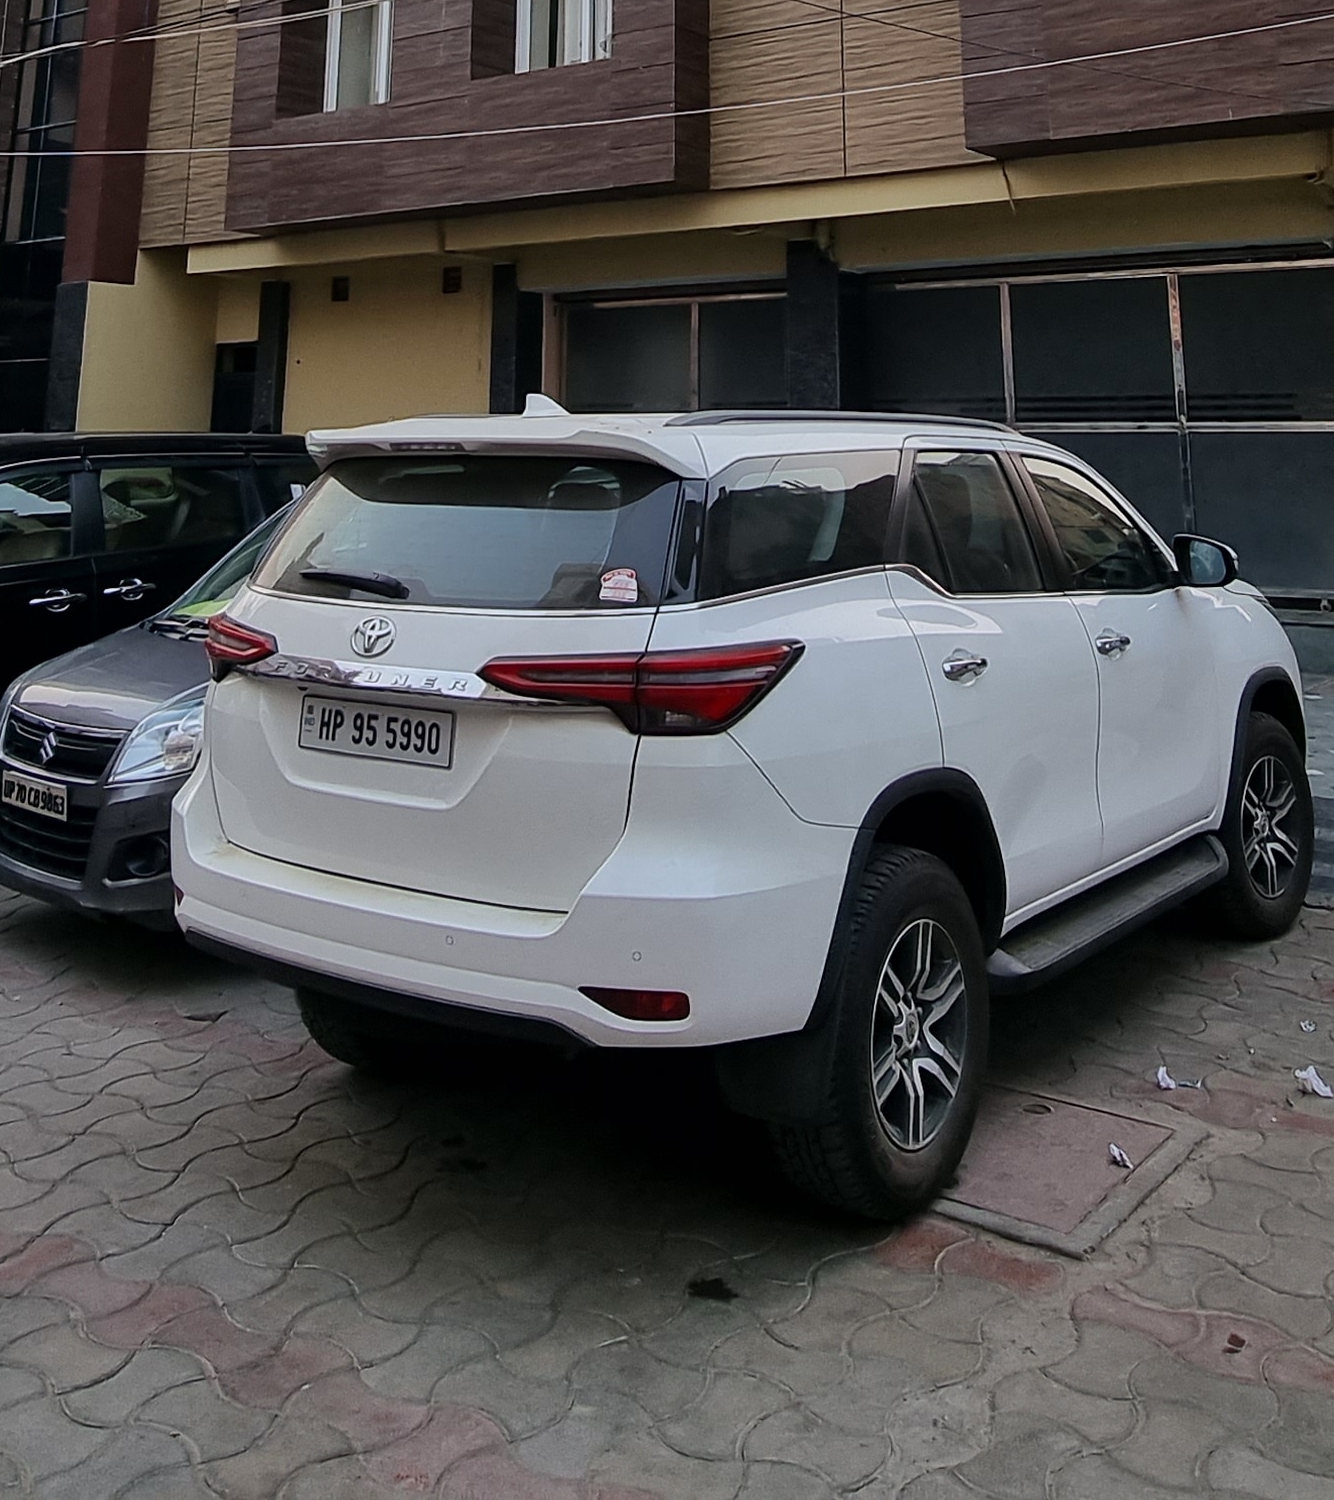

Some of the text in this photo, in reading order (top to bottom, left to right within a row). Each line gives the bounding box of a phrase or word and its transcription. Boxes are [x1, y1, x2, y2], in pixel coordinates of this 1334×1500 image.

[318, 706, 441, 755] HP 95 5990
